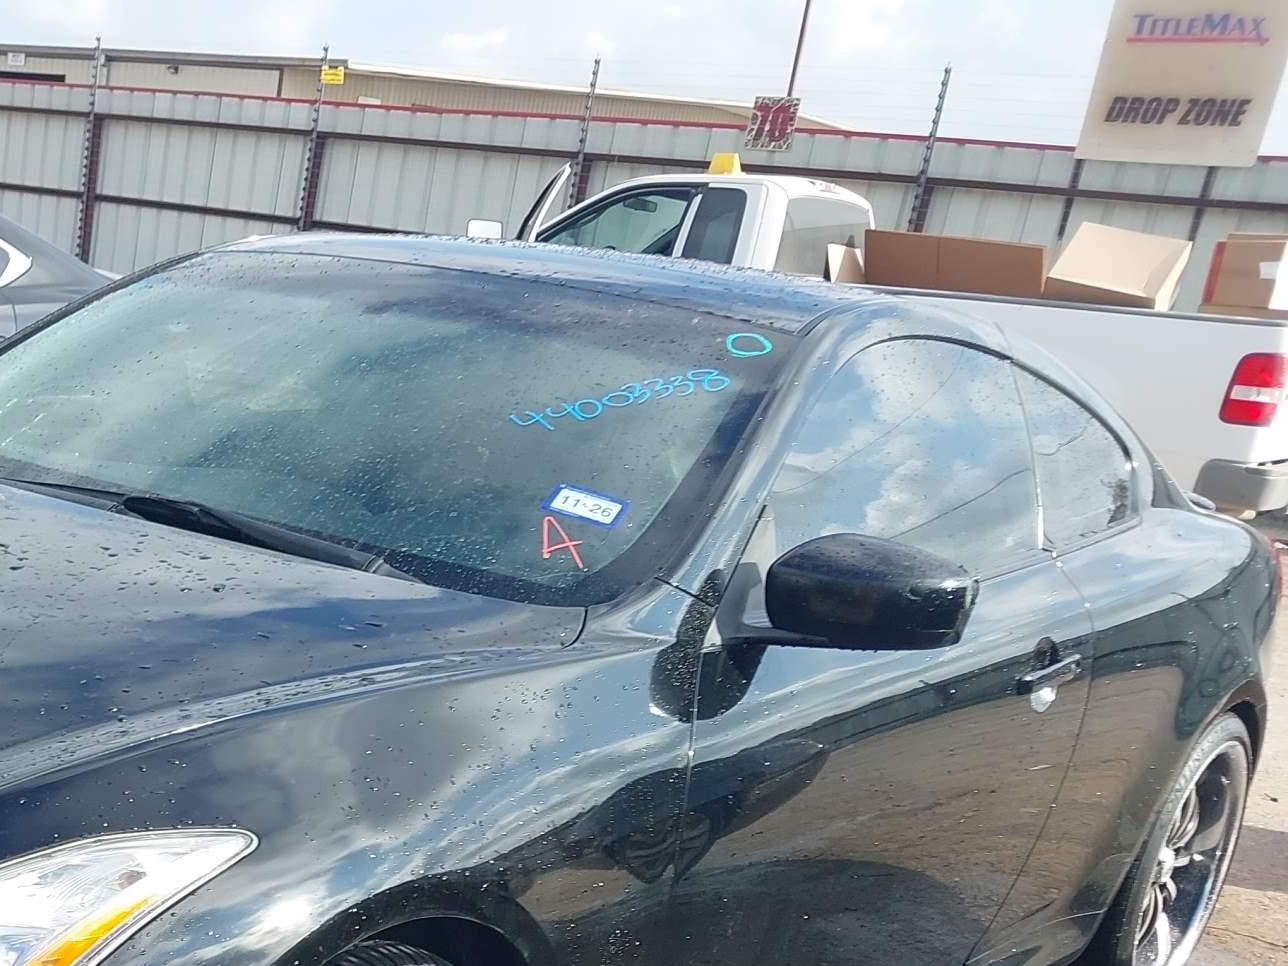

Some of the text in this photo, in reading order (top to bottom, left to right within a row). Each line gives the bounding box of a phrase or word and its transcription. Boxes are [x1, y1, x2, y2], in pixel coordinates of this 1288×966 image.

[1104, 96, 1253, 127] DROP ZONE
[510, 369, 730, 431] 44003338
[542, 516, 584, 569] A
